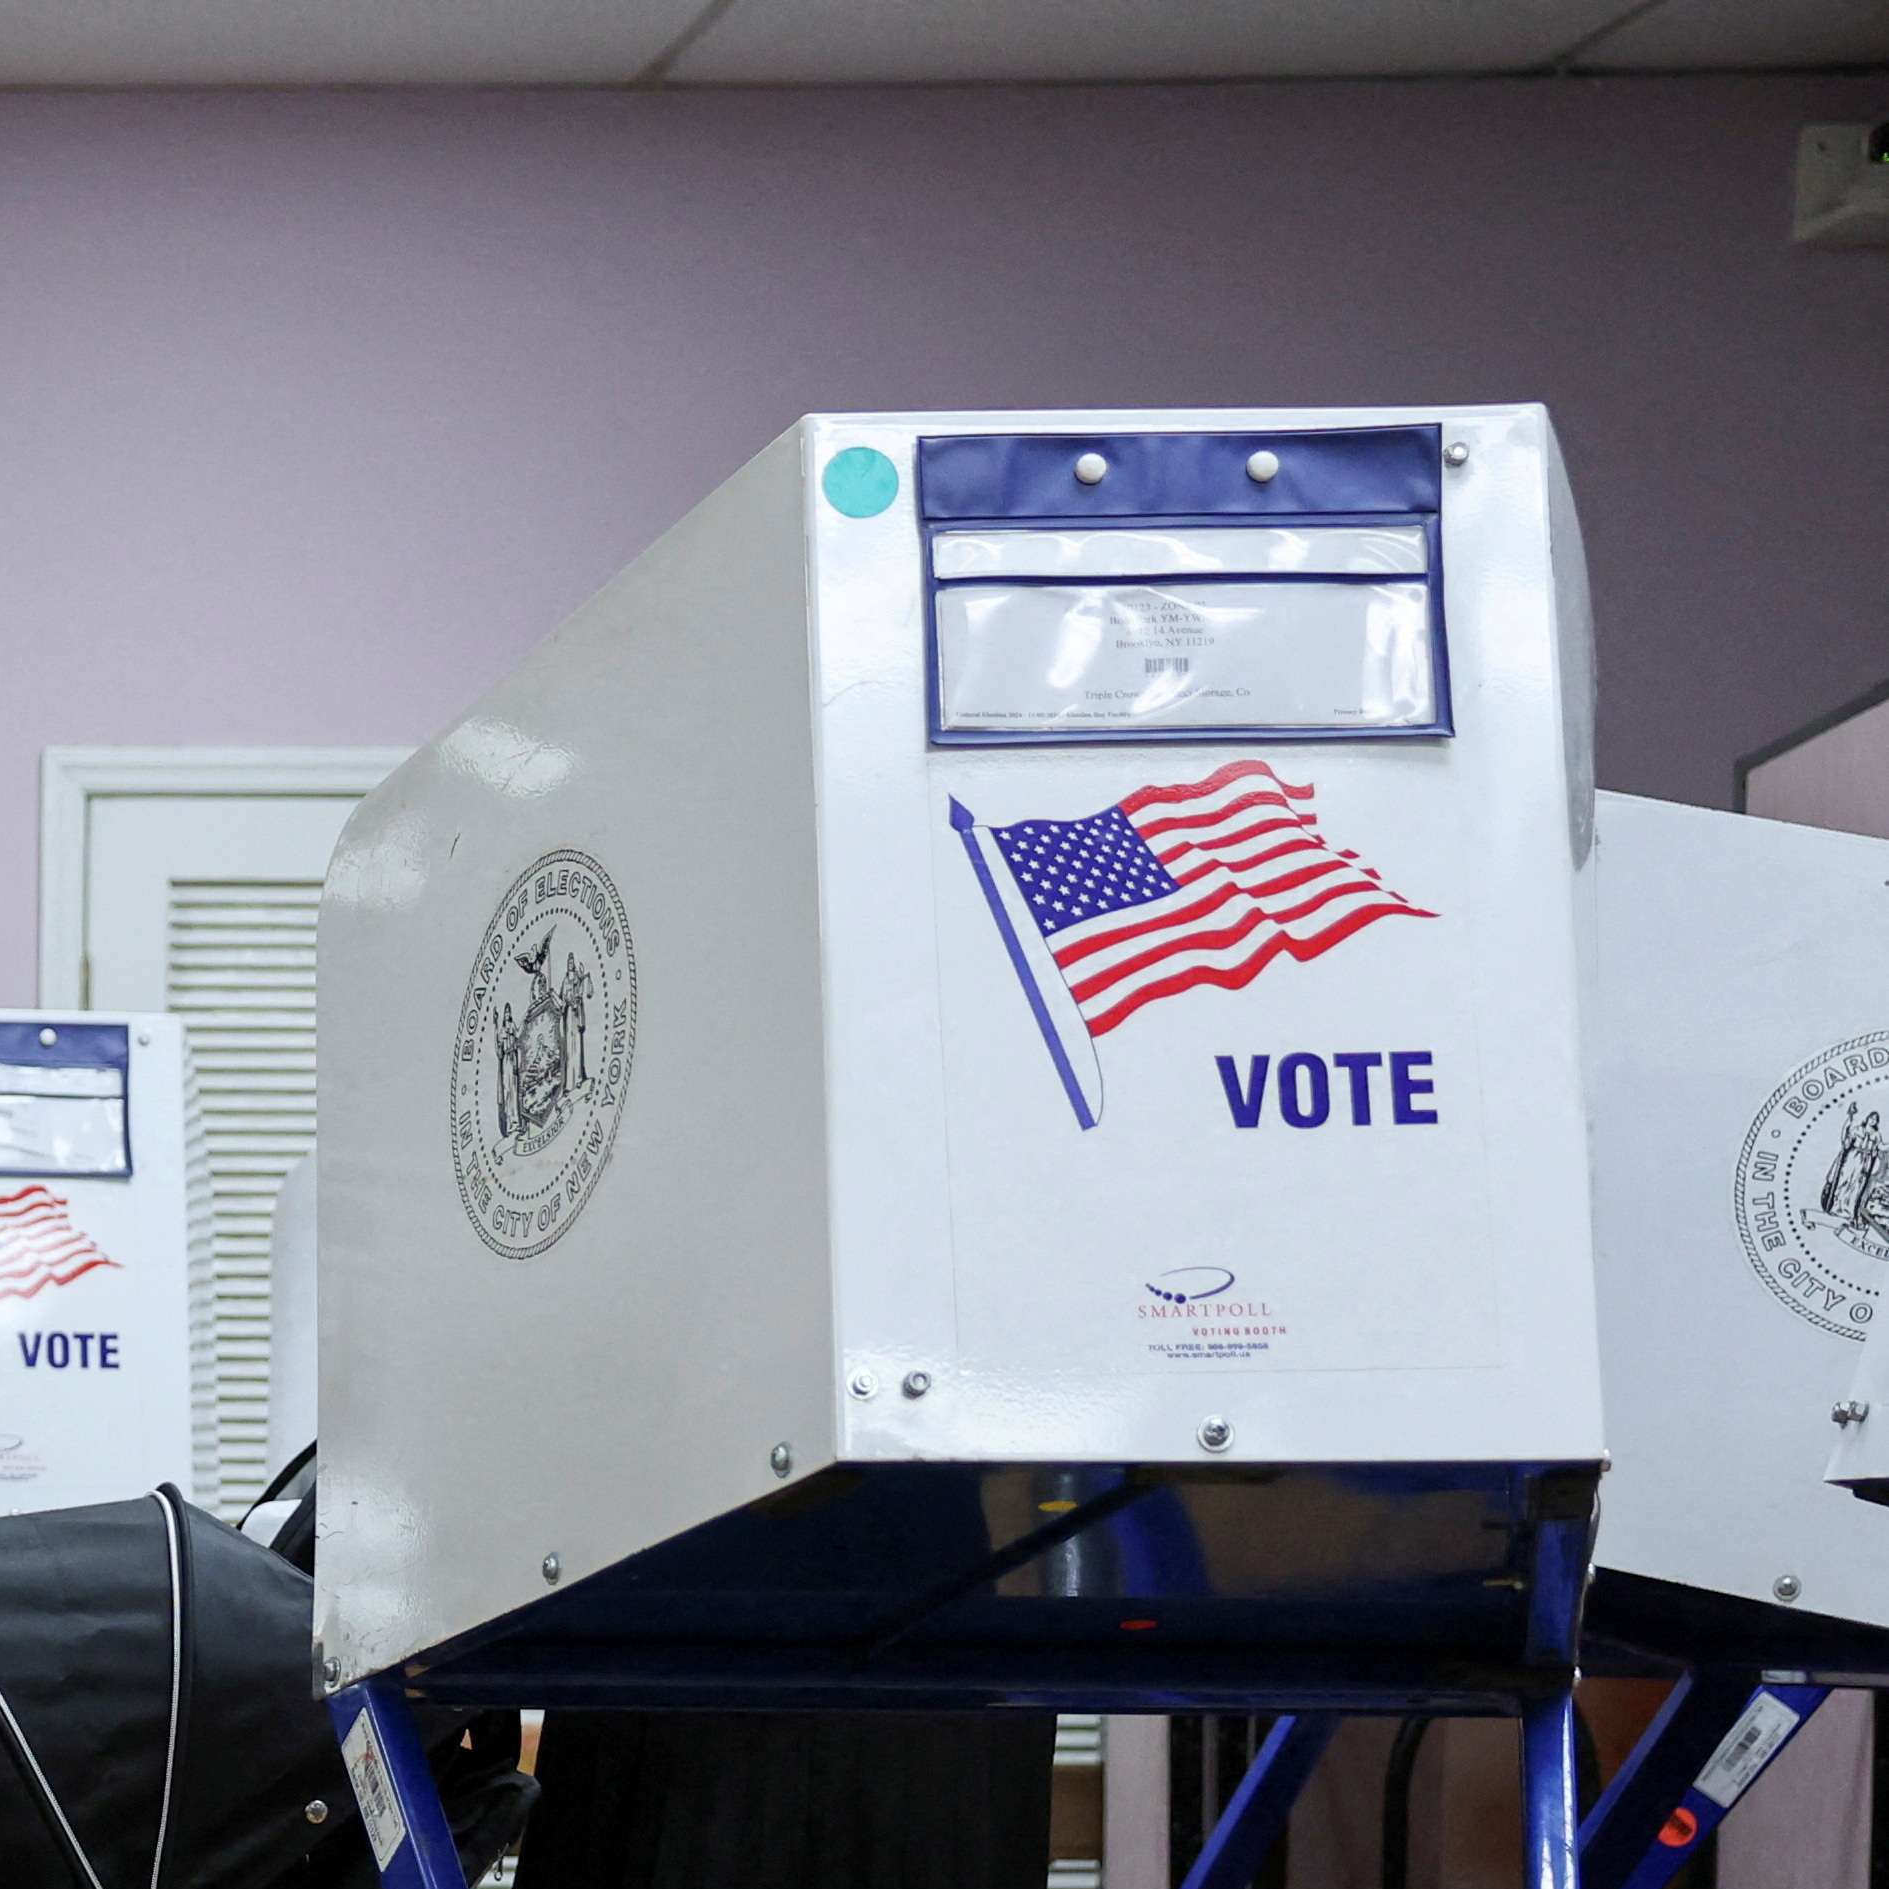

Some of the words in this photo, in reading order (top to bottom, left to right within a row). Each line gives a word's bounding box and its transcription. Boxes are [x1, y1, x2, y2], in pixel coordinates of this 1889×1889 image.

[1166, 638, 1182, 647] NY
[1186, 637, 1215, 646] 11219
[1114, 691, 1140, 699] Crow
[462, 934, 503, 1062] BOARD
[506, 889, 528, 932] OF
[535, 869, 620, 957] ELECTIONS
[1216, 1052, 1439, 1127] VOTE
[1783, 1046, 1889, 1119] BOARD
[459, 1111, 473, 1150] IN
[466, 1151, 492, 1214] THE
[492, 1204, 533, 1238] CITY
[537, 1193, 561, 1231] OF
[566, 1119, 604, 1204] NEW
[601, 998, 627, 1107] YORK
[1752, 1150, 1779, 1182] IN
[1753, 1191, 1786, 1252] THE
[1778, 1257, 1847, 1311] CITY
[1138, 1303, 1270, 1319] SMARTPOLL
[1192, 1327, 1240, 1336] VOTING
[1244, 1326, 1287, 1335] BOOTH
[18, 1332, 120, 1369] VOTE
